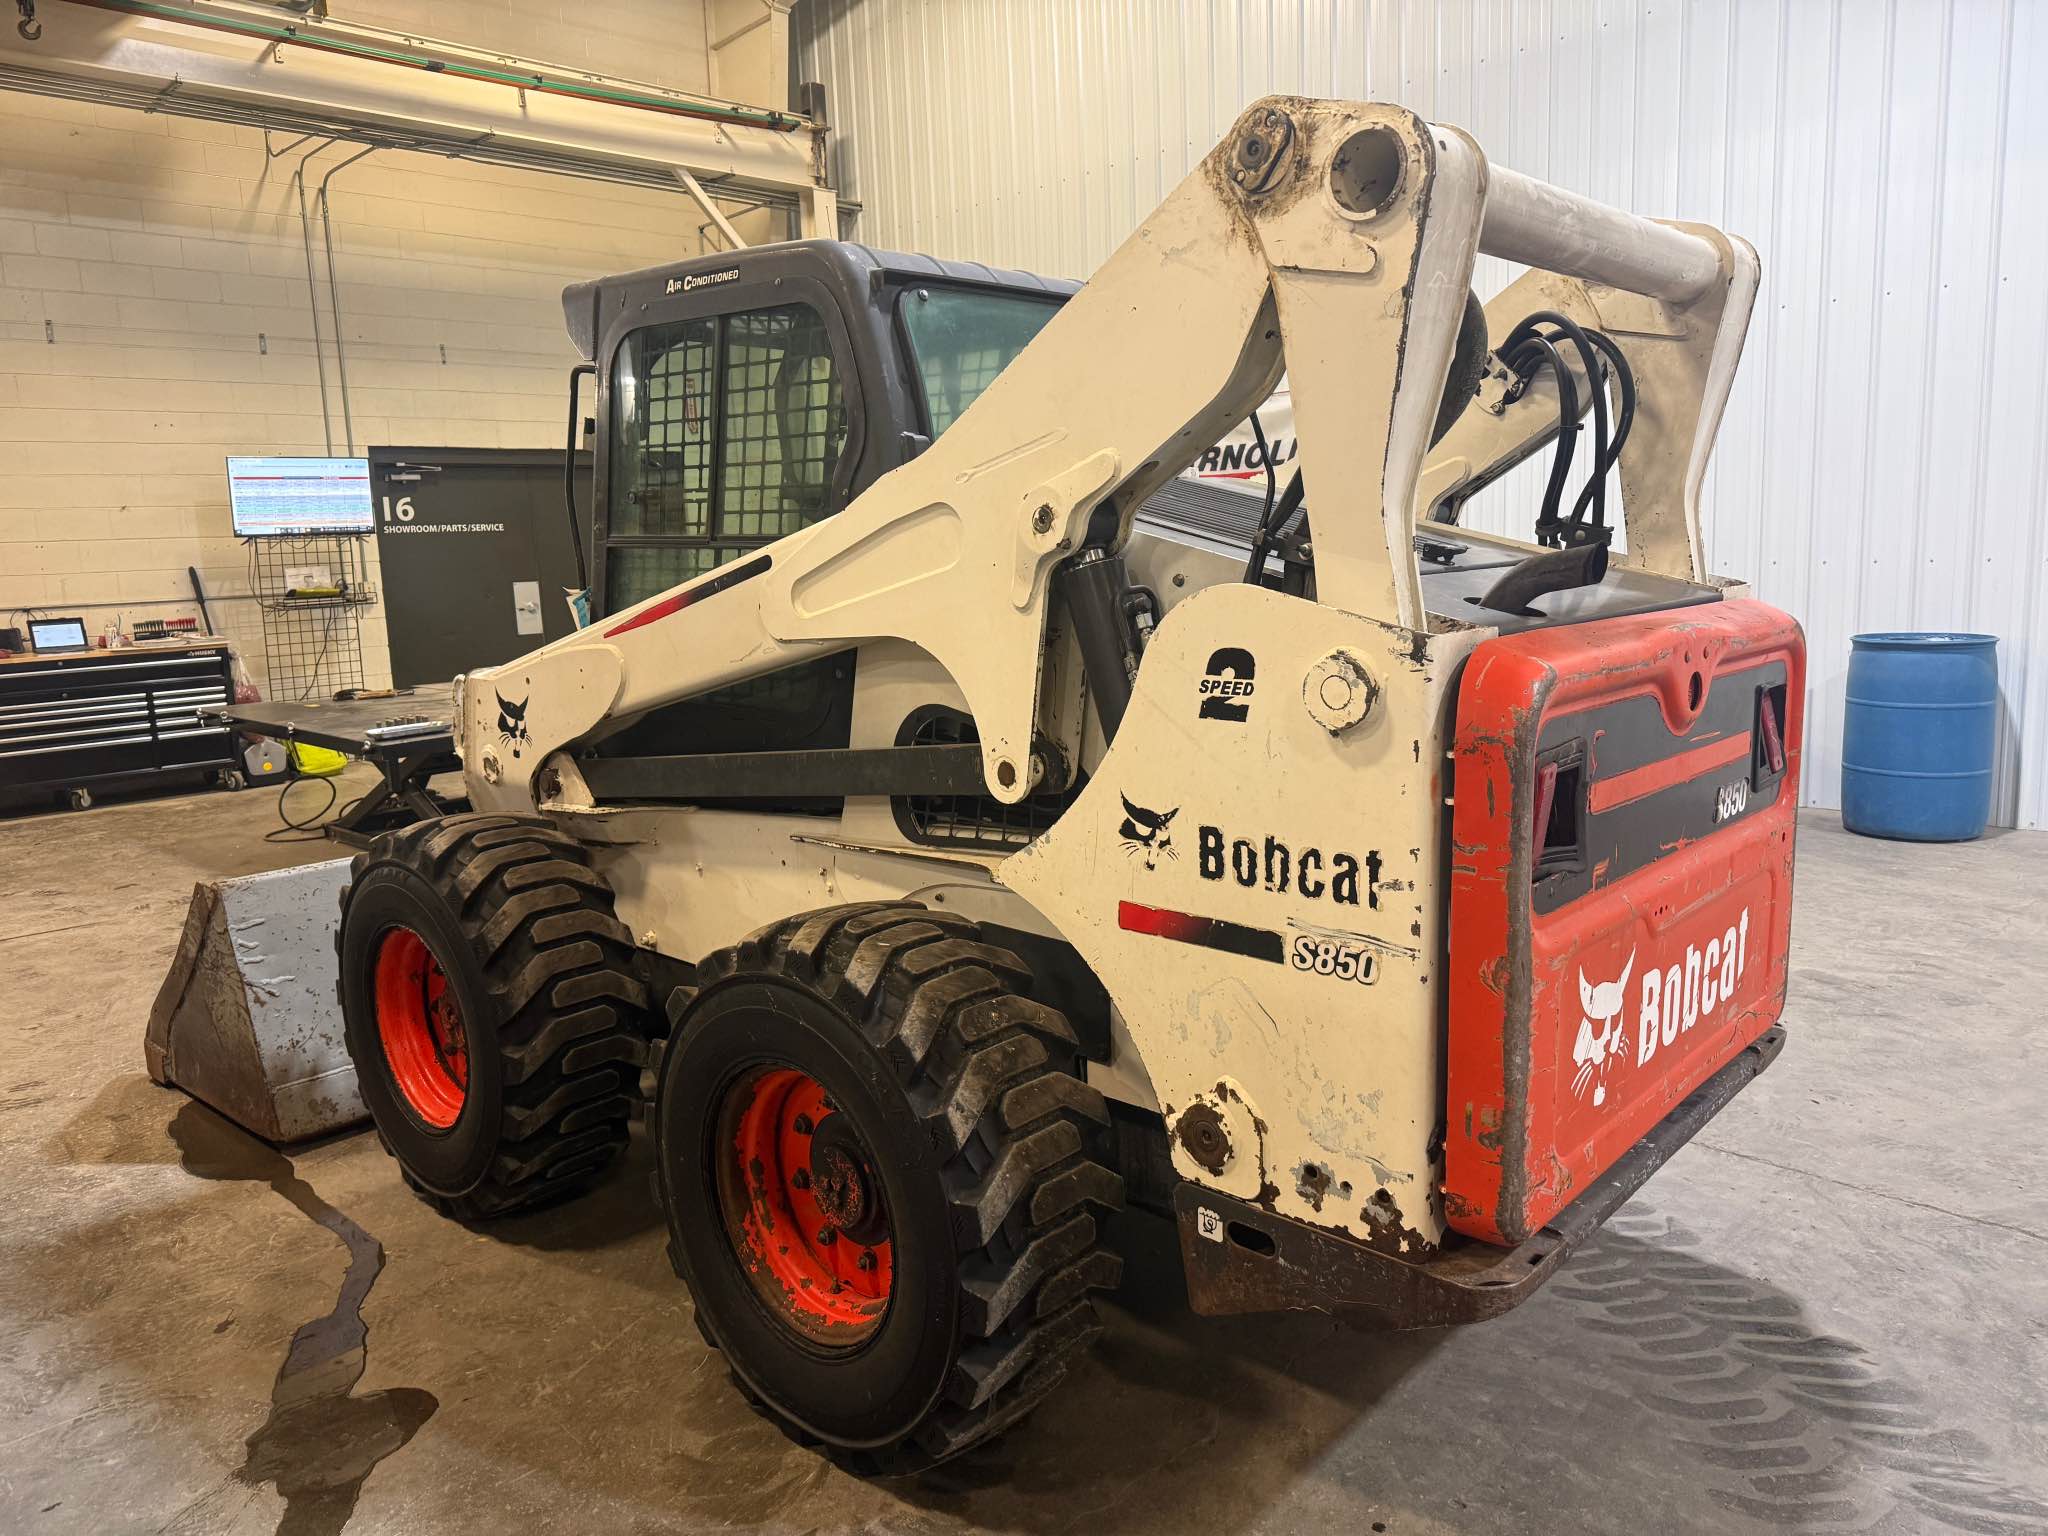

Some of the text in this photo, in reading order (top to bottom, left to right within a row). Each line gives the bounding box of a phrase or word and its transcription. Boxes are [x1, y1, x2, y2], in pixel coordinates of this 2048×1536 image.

[666, 279, 681, 294] AIR
[383, 523, 505, 534] SHOWROOM/PARTS/SERVICE
[1199, 647, 1256, 722] 2
[1199, 679, 1255, 696] SPEED
[1199, 825, 1383, 911] Bobcat
[1292, 935, 1381, 986] S850
[1637, 906, 1749, 1068] Bobcat
